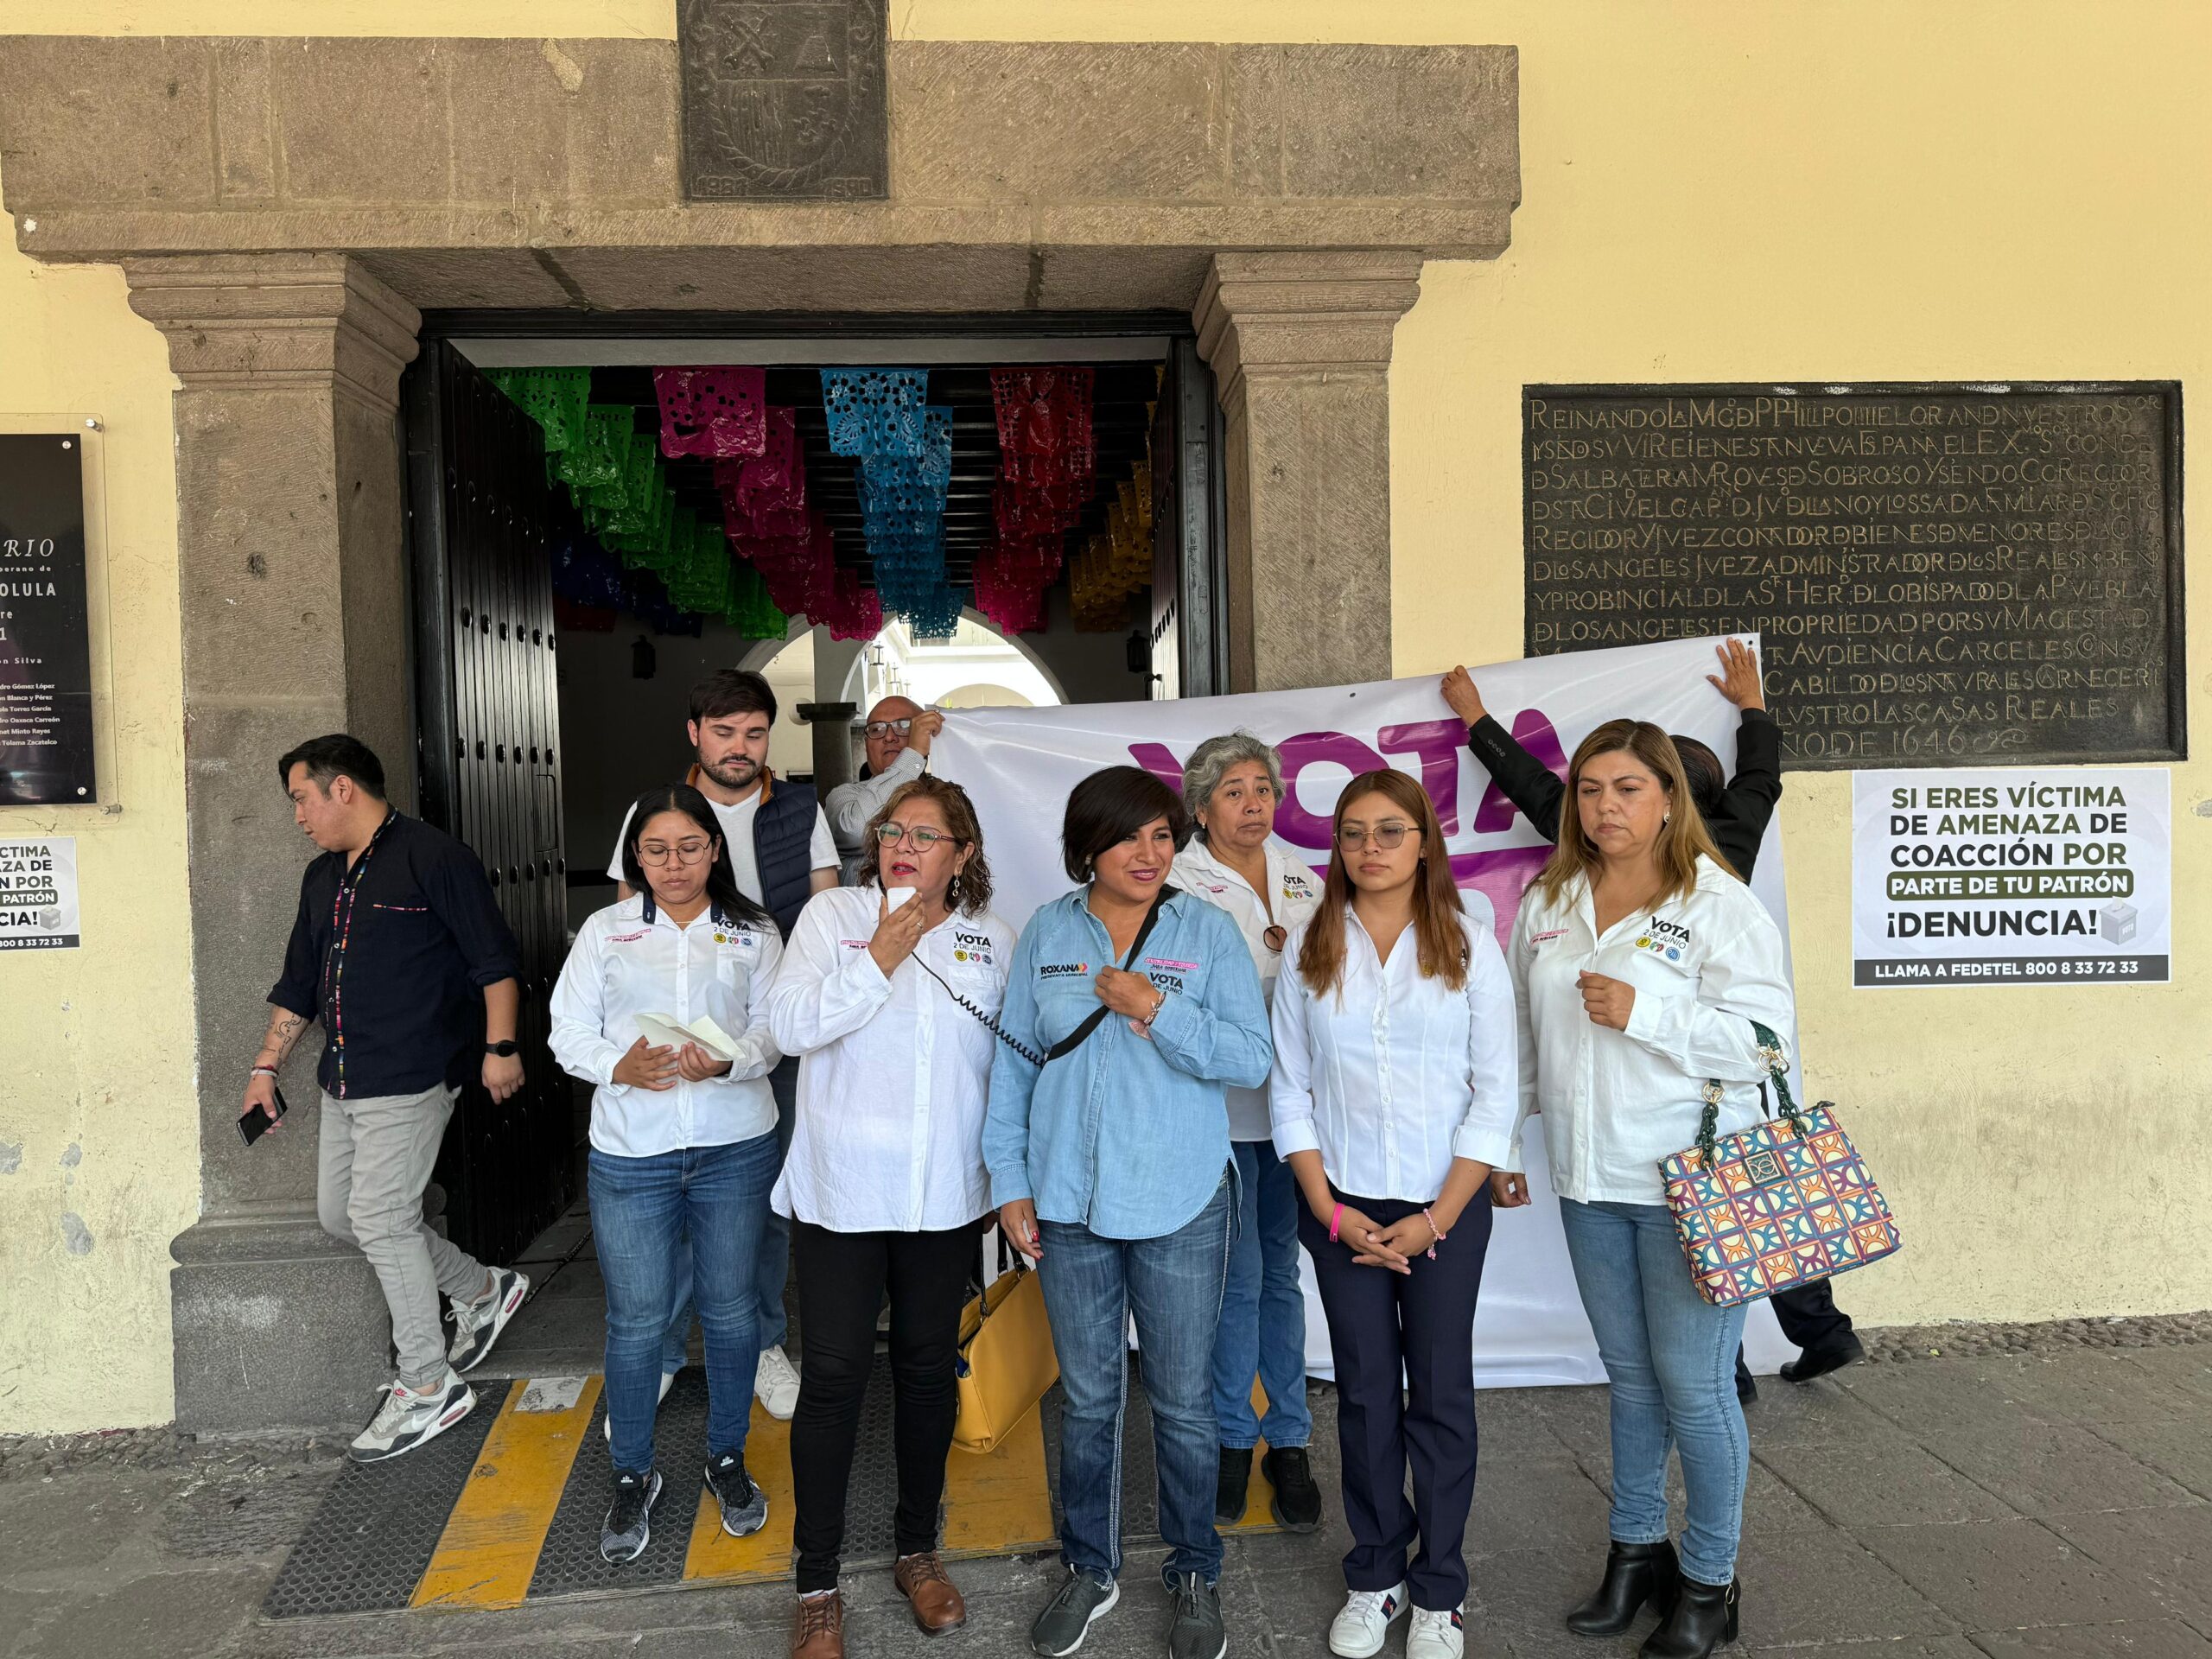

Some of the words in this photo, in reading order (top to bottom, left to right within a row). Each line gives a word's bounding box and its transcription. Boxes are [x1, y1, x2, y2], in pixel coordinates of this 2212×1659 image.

[1891, 787, 1917, 810] SI
[1927, 787, 1999, 809] ERES
[2006, 781, 2127, 809] VÍCTIMA
[1891, 814, 1928, 836] DE
[1936, 813, 2082, 836] AMENAZA
[2090, 813, 2127, 835] DE
[1891, 837, 2053, 868] COACCIÓN
[2064, 842, 2127, 865] POR
[0, 861, 25, 872] ZA
[31, 860, 53, 871] DE
[16, 875, 53, 888] POR
[1283, 874, 1306, 884] OTA
[1891, 877, 1963, 895] PARTE
[1968, 876, 1998, 894] DE
[2003, 875, 2033, 893] TU
[2039, 871, 2128, 893] PATRÓN
[3, 891, 54, 903] PATRÓN
[717, 918, 751, 931] VOTA
[1651, 916, 1690, 943] VOTA
[1887, 909, 2097, 938] ¡DENUNCIA!
[955, 931, 992, 948] VOTA
[1649, 931, 1660, 939] DE
[1662, 935, 1686, 949] JUNIO
[972, 944, 992, 954] JUNIO
[1040, 964, 1079, 975] ROXANA
[1875, 964, 1930, 978] LLAMA
[1935, 963, 1947, 976] A
[1951, 962, 2022, 976] FEDETEL
[2024, 962, 2057, 976] 800
[2060, 961, 2072, 975] 8
[2075, 961, 2094, 975] 33
[2096, 960, 2116, 974] 72
[2119, 960, 2139, 974] 33
[1150, 972, 1183, 989] VOTA
[1163, 986, 1182, 995] JUNIO
